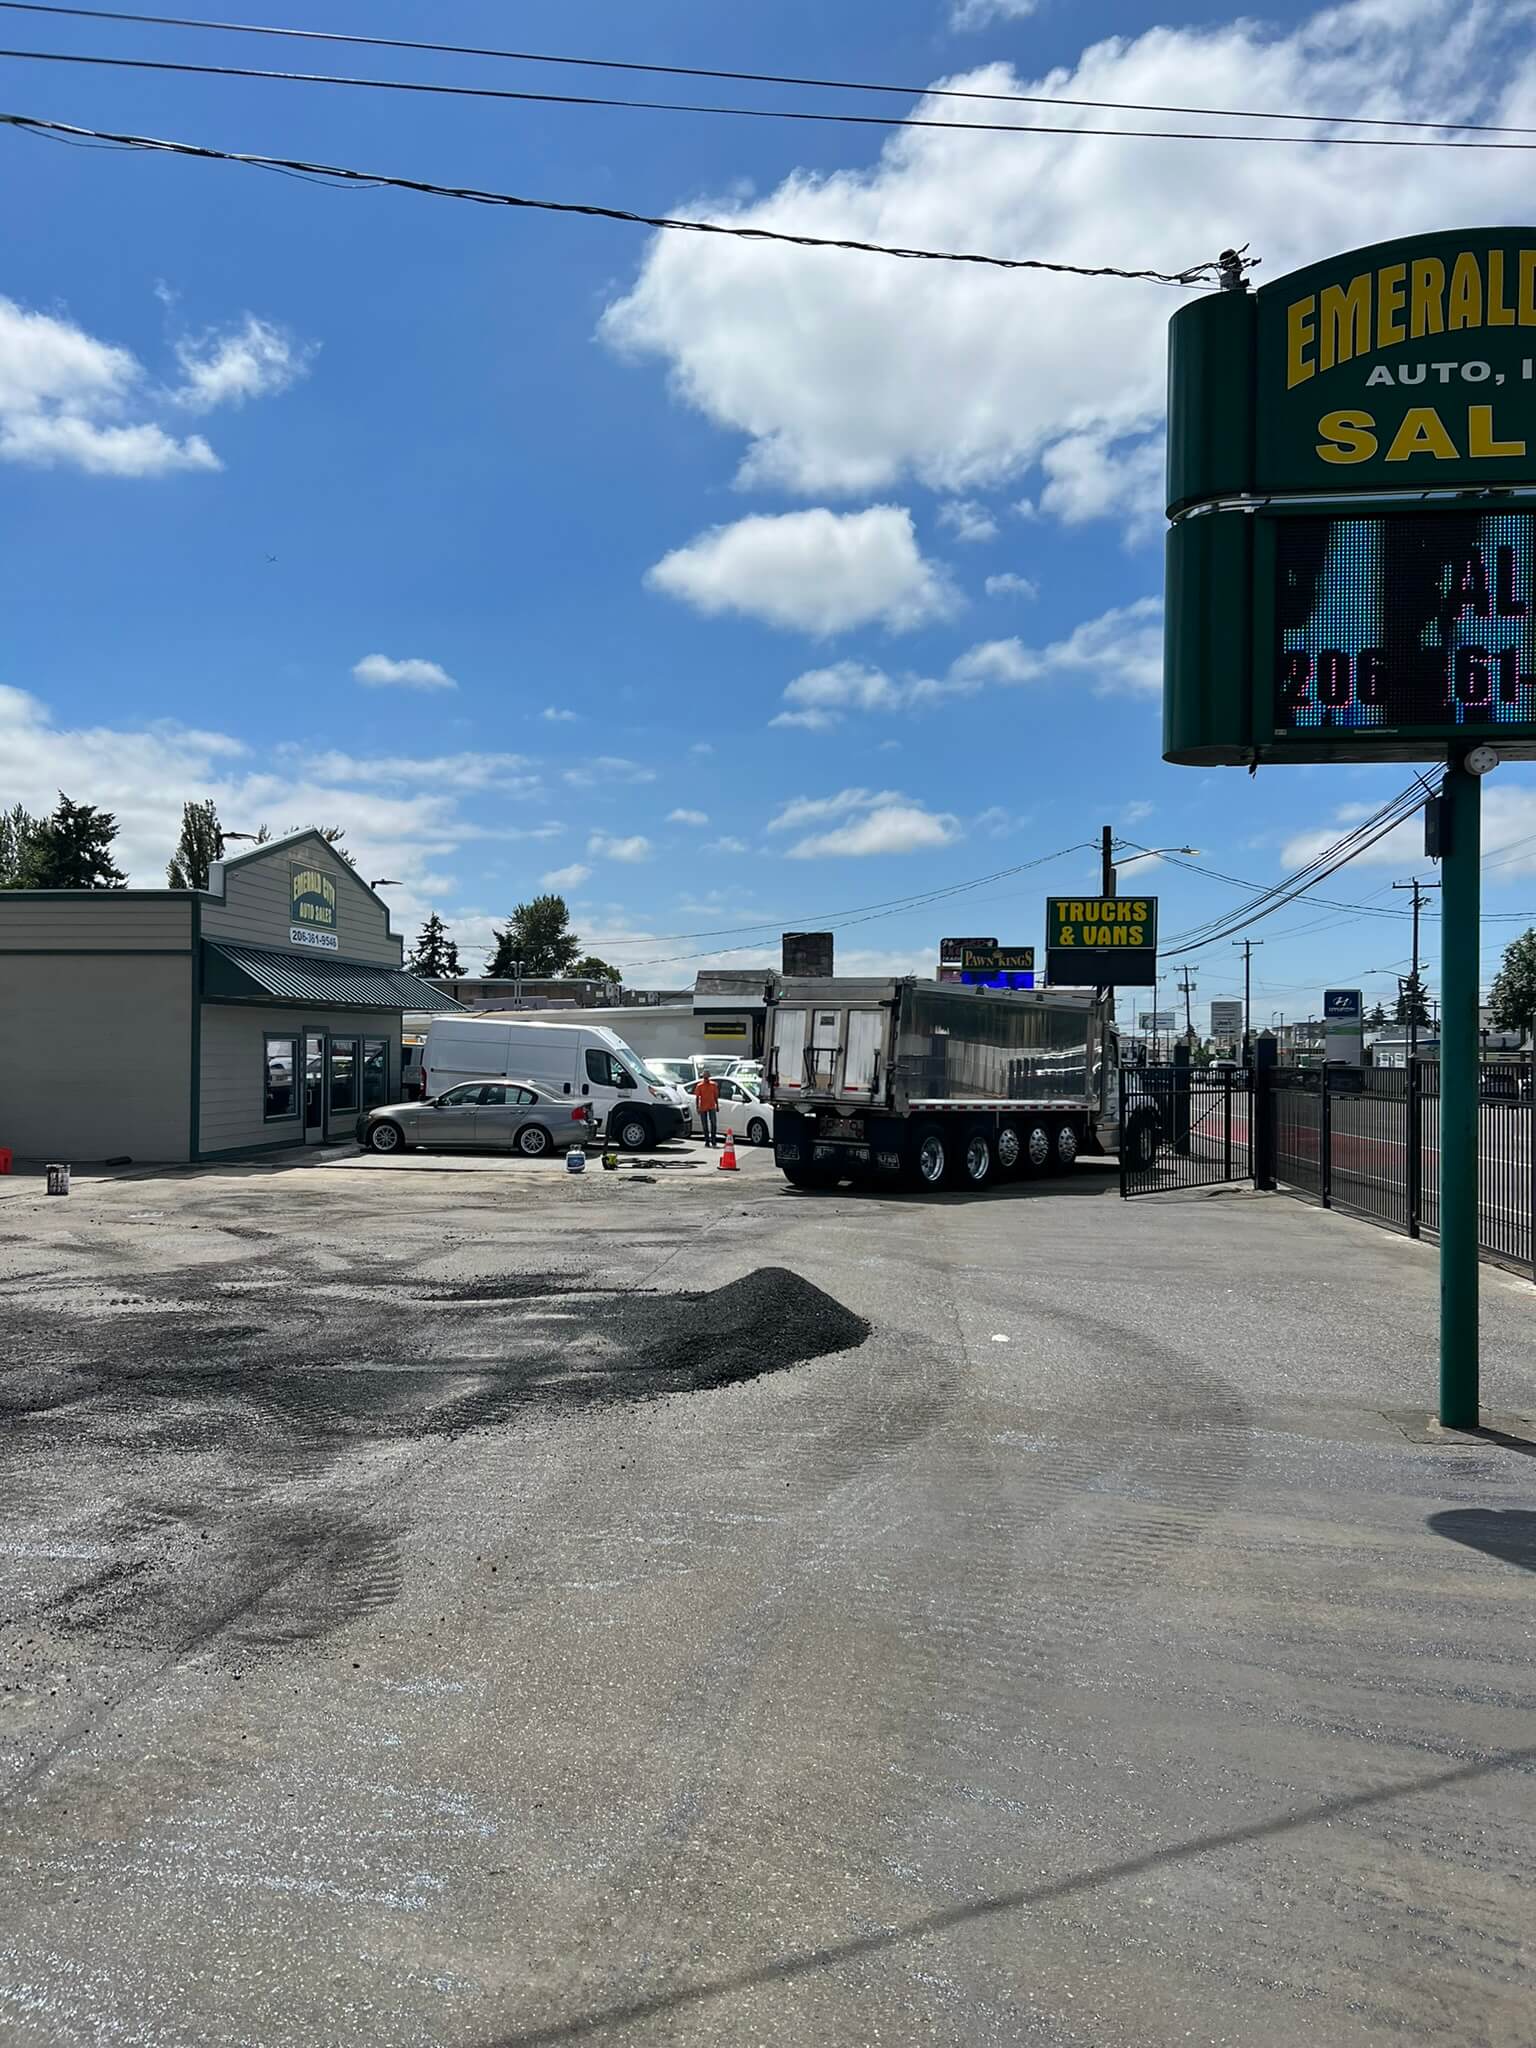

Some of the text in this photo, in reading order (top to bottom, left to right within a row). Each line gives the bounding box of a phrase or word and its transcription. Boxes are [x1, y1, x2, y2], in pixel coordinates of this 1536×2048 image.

[1365, 361, 1505, 386] AUTO,
[1283, 651, 1385, 708] 206
[293, 871, 321, 902] EMERALD
[300, 902, 332, 923] AUTO SALES
[1056, 902, 1147, 922] TRUCKS
[1060, 926, 1143, 945] & VANS
[965, 950, 993, 967] PAWN
[998, 950, 1033, 967] KINGS
